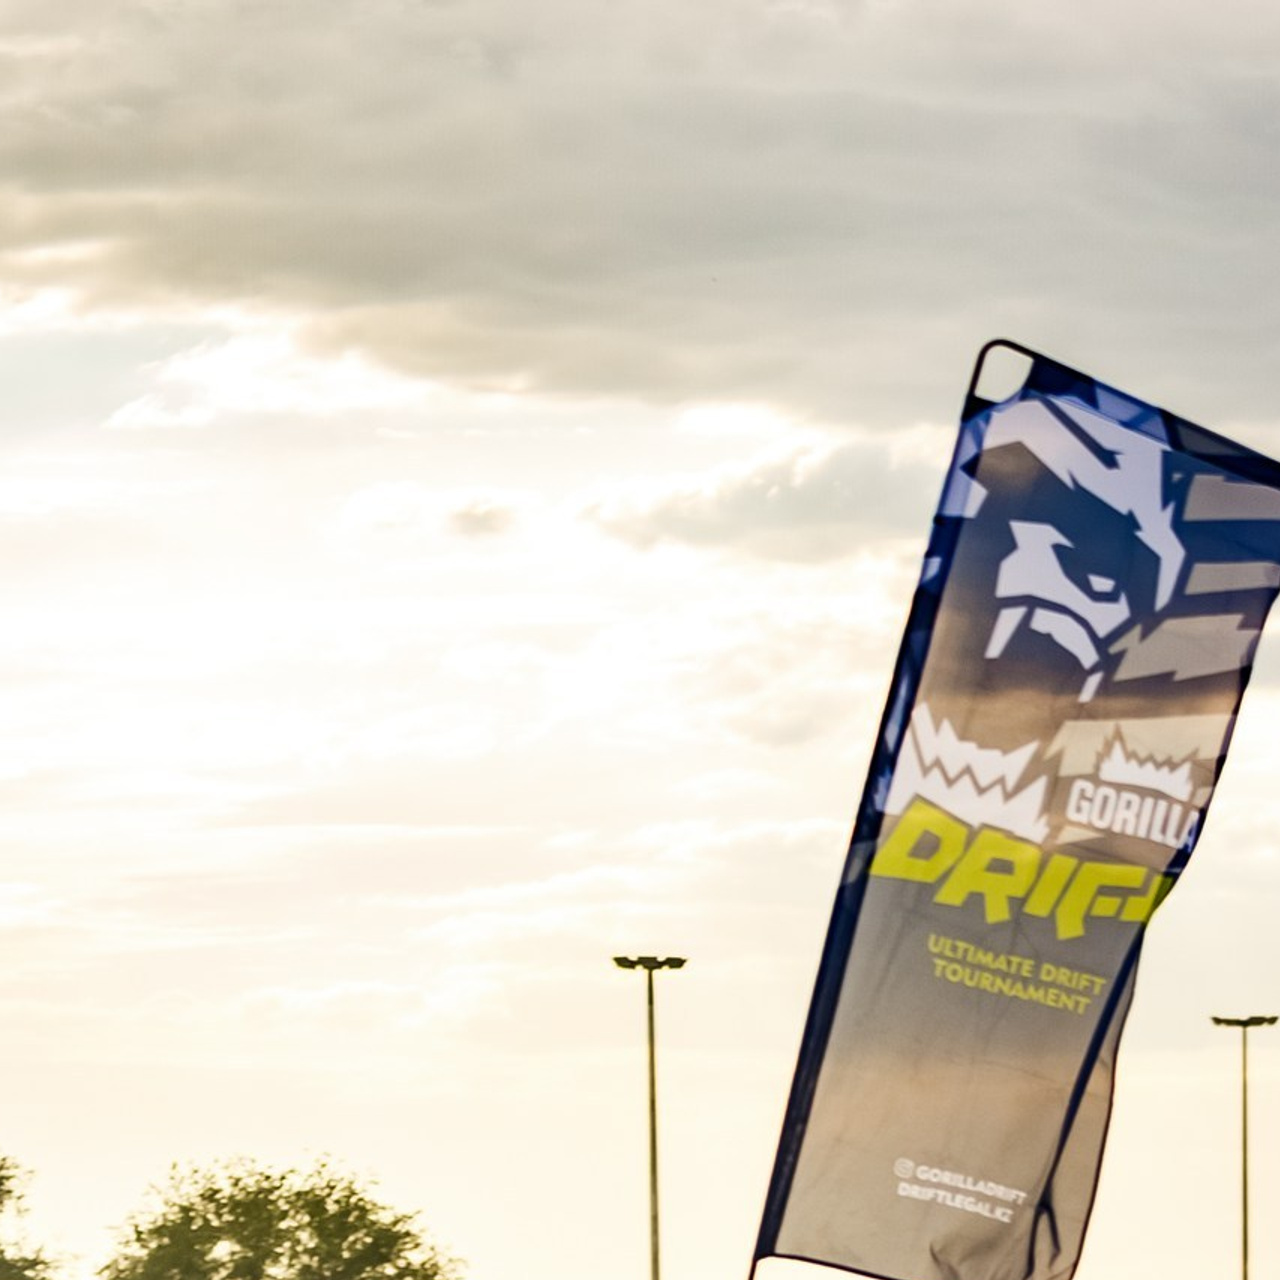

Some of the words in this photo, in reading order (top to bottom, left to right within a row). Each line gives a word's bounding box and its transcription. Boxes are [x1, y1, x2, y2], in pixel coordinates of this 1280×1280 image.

[928, 934, 1034, 977] ULTIMATE
[1040, 962, 1107, 995] DRIFT
[933, 958, 1092, 1014] TOURNAMENT
